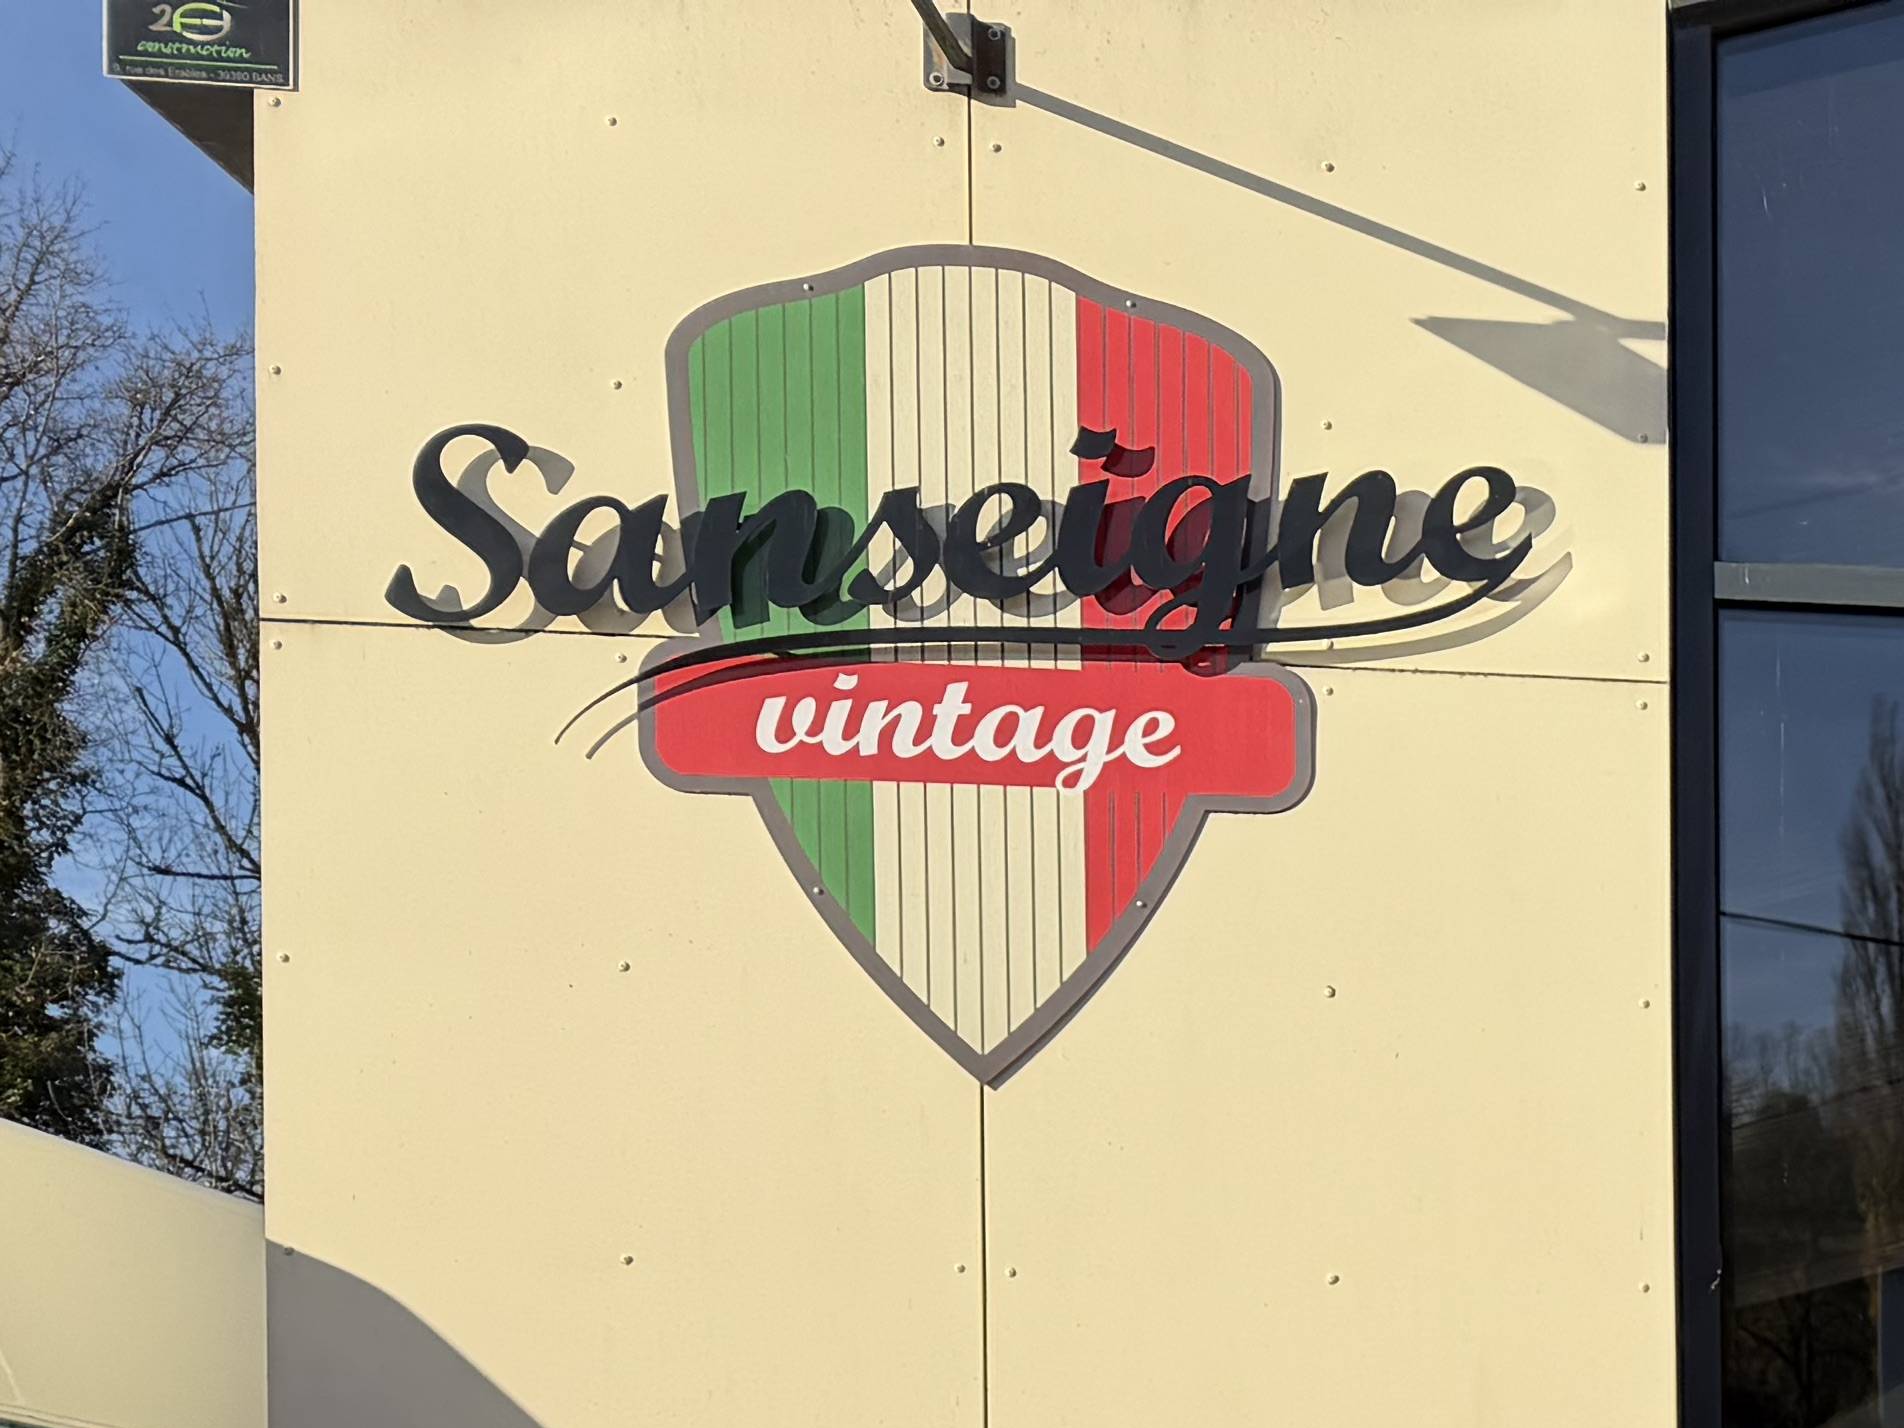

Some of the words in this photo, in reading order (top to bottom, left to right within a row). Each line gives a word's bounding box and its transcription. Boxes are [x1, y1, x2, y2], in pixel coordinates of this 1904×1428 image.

[137, 40, 251, 58] construction
[385, 422, 1534, 650] Sanseigne
[753, 673, 1182, 793] vintage
